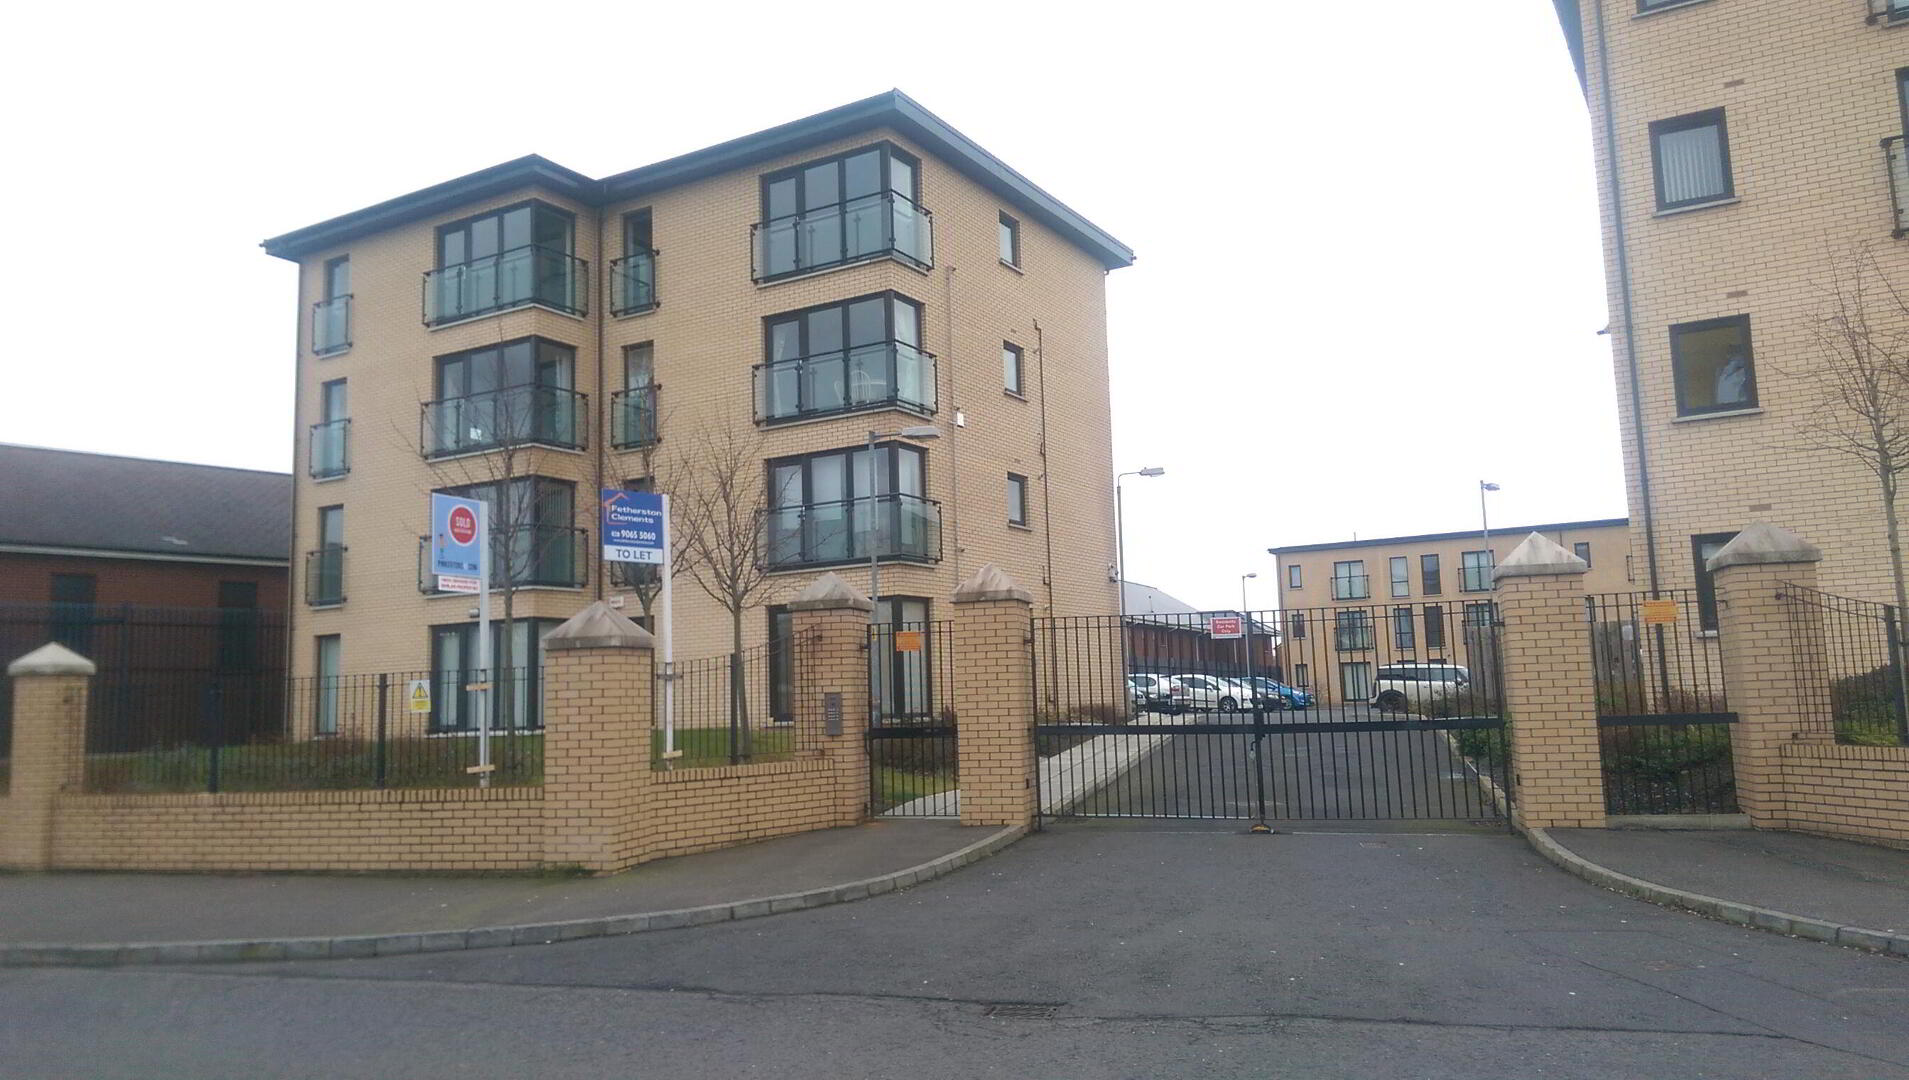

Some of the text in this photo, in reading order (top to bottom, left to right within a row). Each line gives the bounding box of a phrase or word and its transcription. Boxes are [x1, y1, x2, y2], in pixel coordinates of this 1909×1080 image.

[611, 504, 662, 516] Fetherston
[455, 516, 472, 528] SOLD
[611, 513, 654, 523] Clements
[621, 530, 638, 538] 9065
[639, 532, 656, 540] 5060
[616, 549, 652, 560] TO LET
